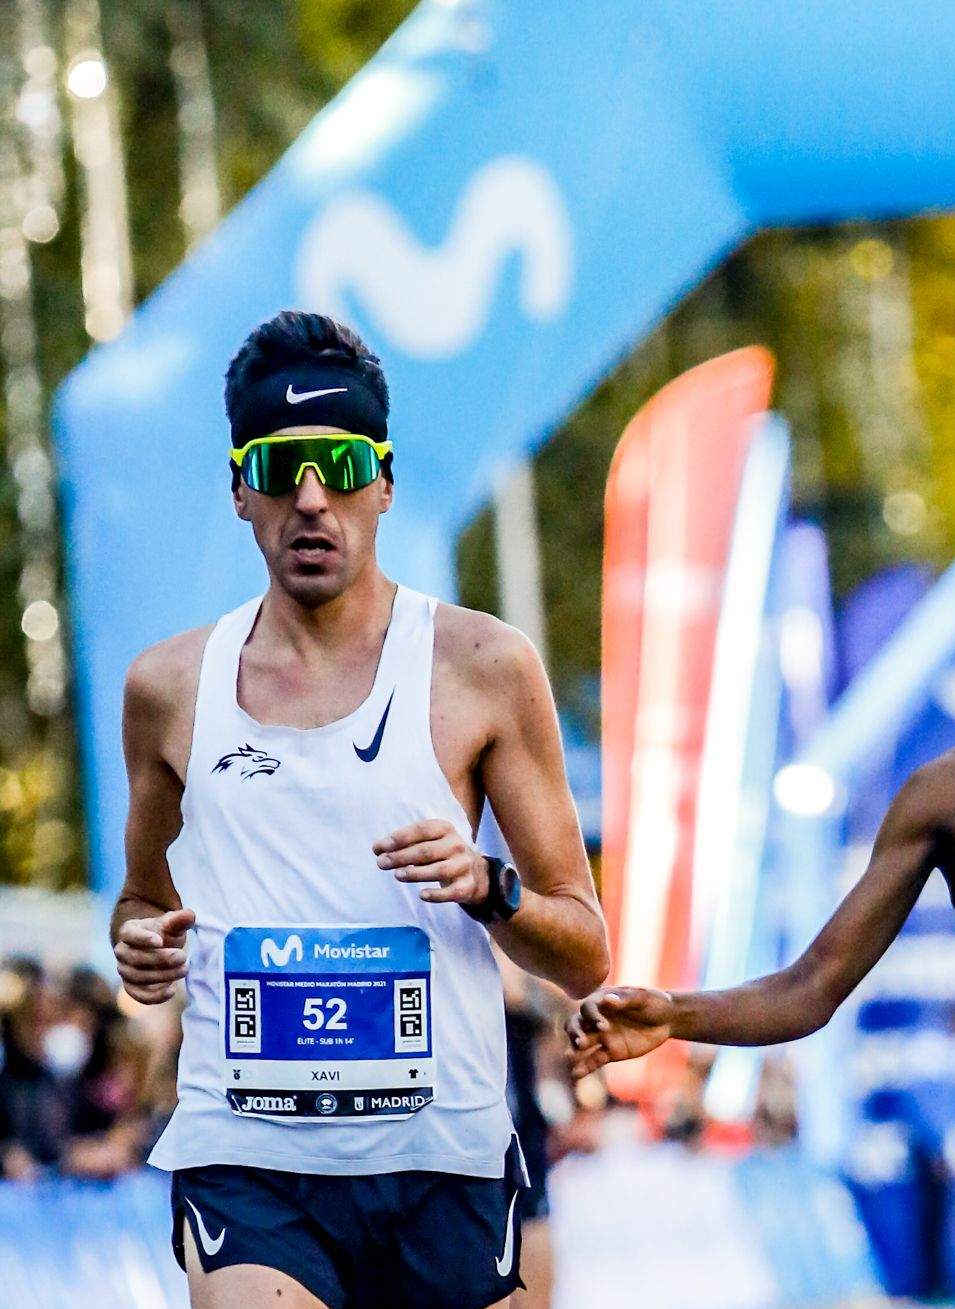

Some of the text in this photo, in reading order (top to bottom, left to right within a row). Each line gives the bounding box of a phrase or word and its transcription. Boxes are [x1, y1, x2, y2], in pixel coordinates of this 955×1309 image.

[313, 943, 391, 959] Movistar
[302, 997, 348, 1031] 52
[319, 1037, 334, 1045] SUB
[311, 1070, 341, 1082] XAVI
[371, 1095, 426, 1109] MADRID
